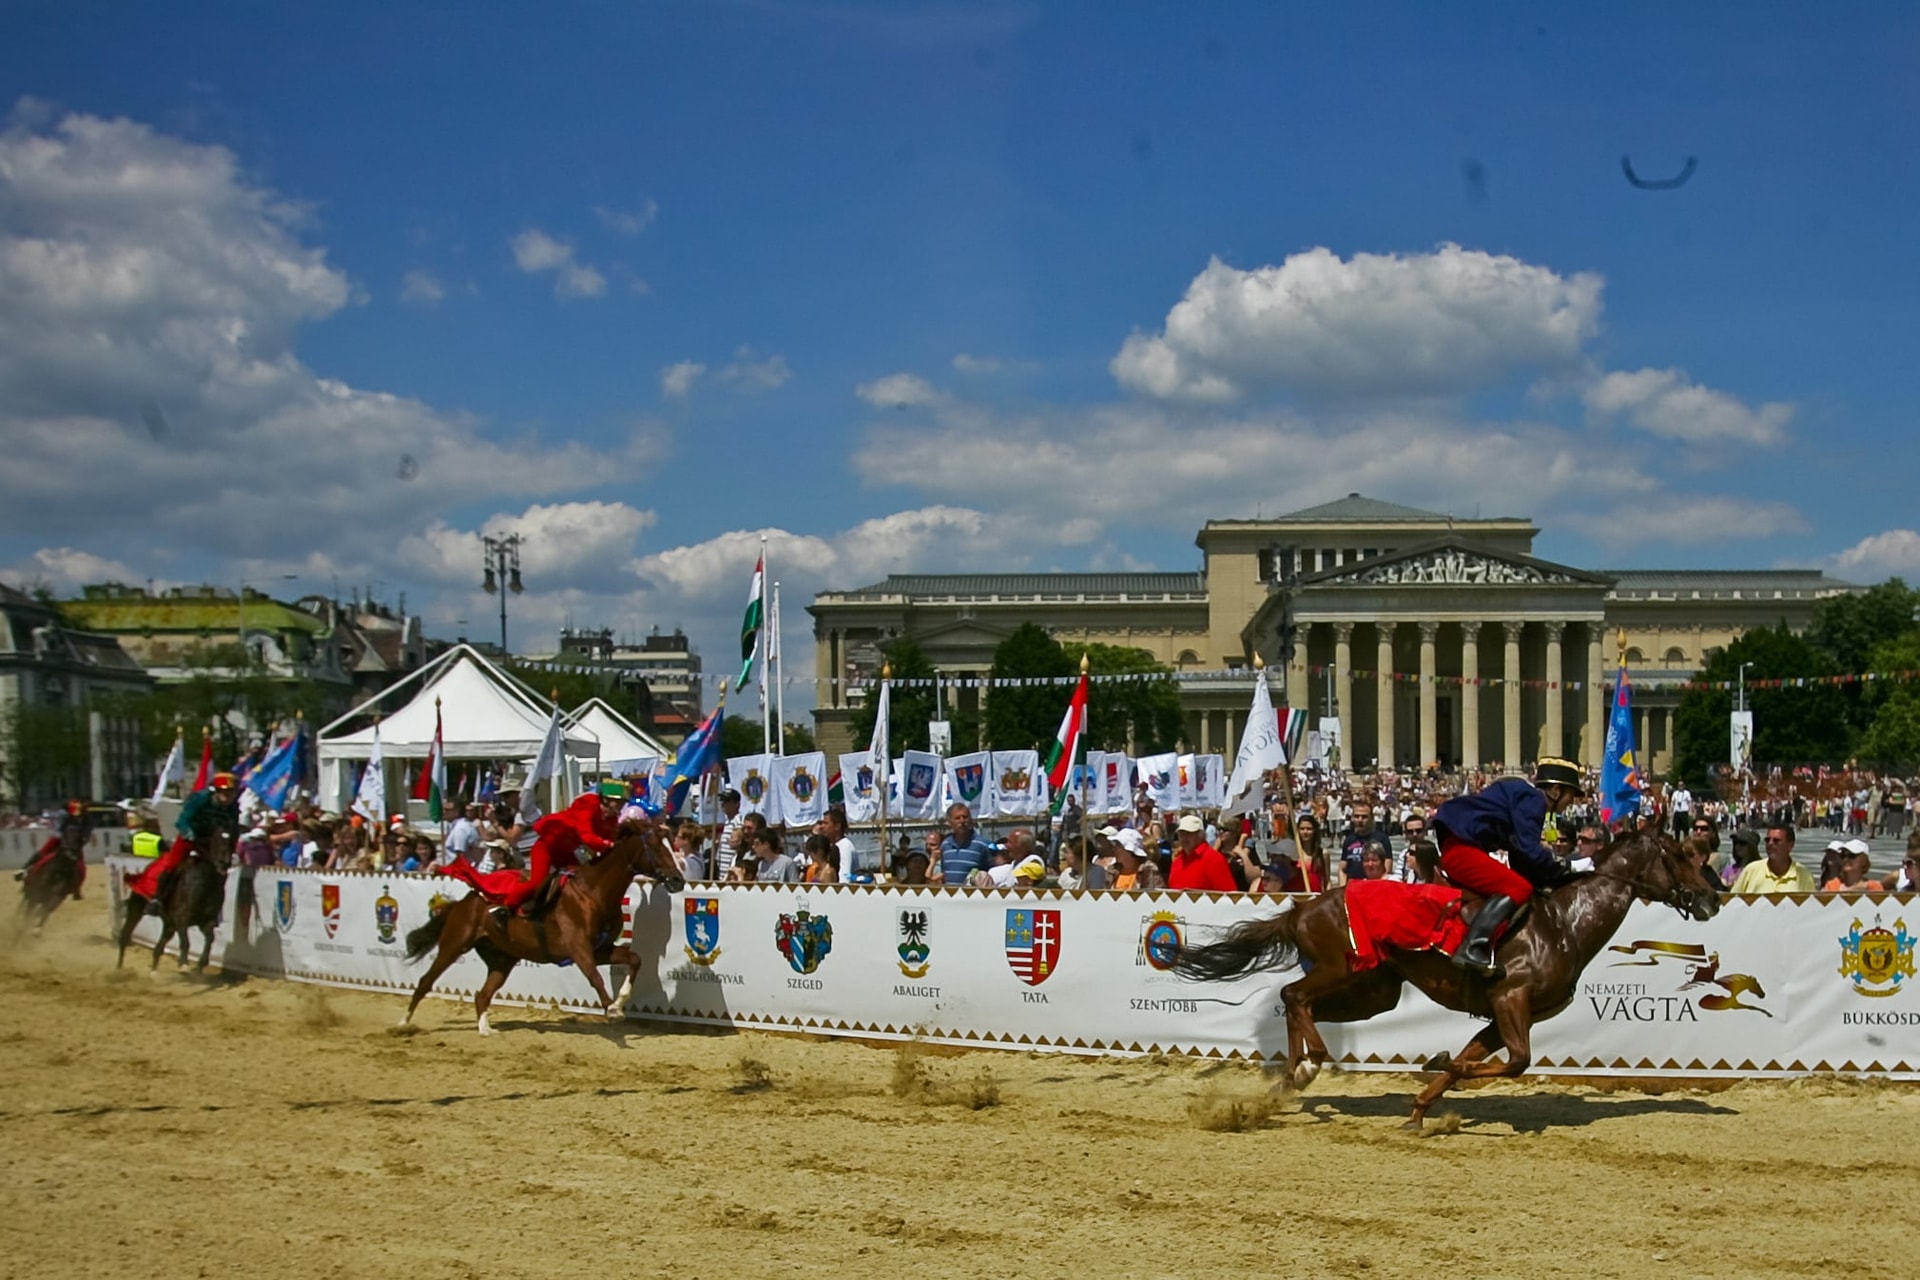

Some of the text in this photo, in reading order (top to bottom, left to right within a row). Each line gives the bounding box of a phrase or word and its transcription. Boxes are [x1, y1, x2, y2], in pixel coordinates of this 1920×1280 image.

[787, 978, 823, 990] SZEGED
[1584, 983, 1646, 995] NEMZETI
[892, 985, 941, 998] ABALIGET
[1021, 991, 1049, 1004] TATA
[1130, 998, 1198, 1013] SZENTJOBB
[1588, 996, 1699, 1021] VÁGTA
[1843, 1010, 1920, 1025] BÜKKÖSD
